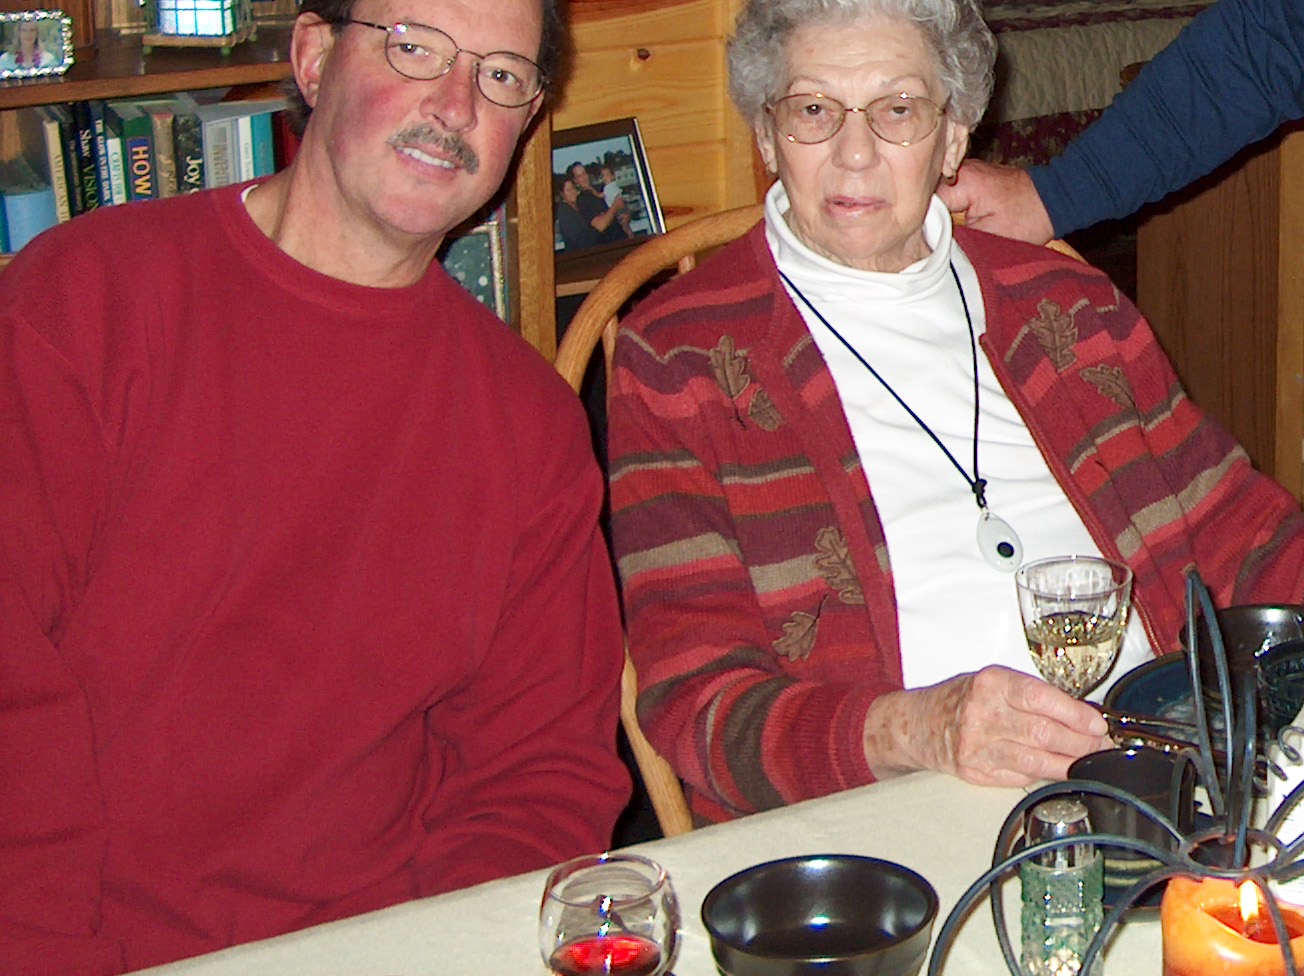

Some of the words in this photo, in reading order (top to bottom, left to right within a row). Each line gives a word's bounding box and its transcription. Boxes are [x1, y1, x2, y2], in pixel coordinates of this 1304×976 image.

[83, 164, 99, 212] VISION
[132, 146, 152, 195] HOW
[183, 155, 203, 184] Joy
